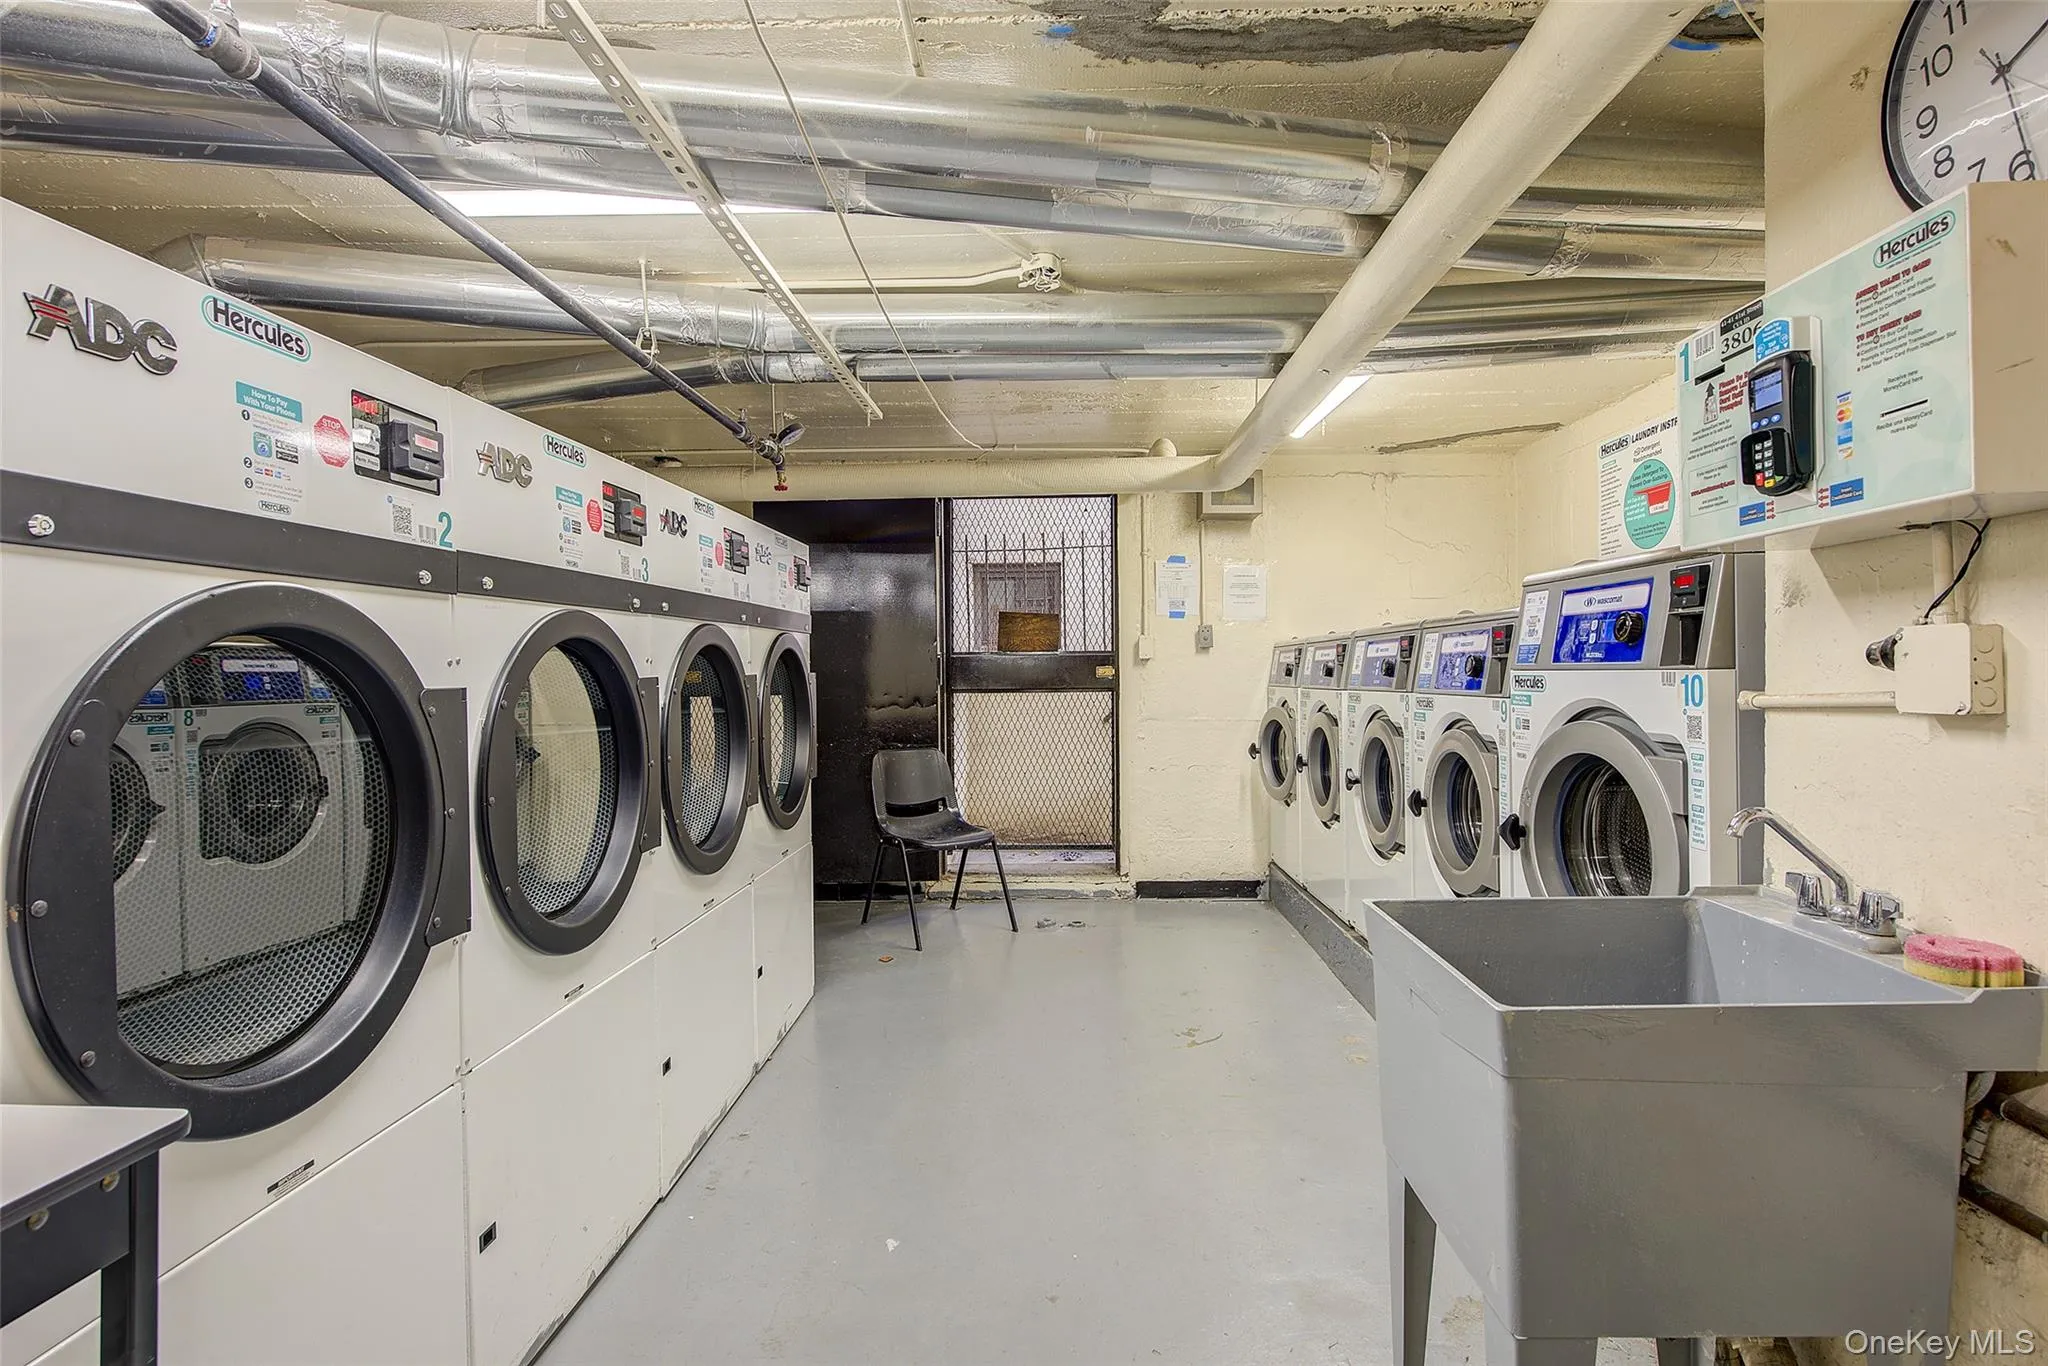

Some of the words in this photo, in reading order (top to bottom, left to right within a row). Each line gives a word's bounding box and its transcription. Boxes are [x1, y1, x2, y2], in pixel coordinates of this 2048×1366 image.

[1943, 1, 1967, 35] 11
[1920, 44, 1953, 87] 10
[1916, 105, 1938, 139] 9
[1934, 144, 1955, 178] 8
[1967, 157, 1986, 182] 7
[1880, 216, 1949, 263] Hercules
[1902, 276, 1914, 285] Card
[1894, 288, 1906, 298] Type
[212, 297, 305, 357] Hercules
[1878, 311, 1890, 320] Card
[22, 283, 178, 376] ADC
[1679, 342, 1690, 382] 1
[1883, 379, 1911, 394] MoneyCard
[1911, 375, 1924, 384] here
[1887, 373, 1907, 384] Receive
[1907, 369, 1919, 378] new
[243, 395, 260, 407] With
[260, 400, 276, 412] Your
[276, 406, 296, 418] Phone
[251, 389, 267, 400] How
[267, 394, 276, 403] To
[276, 397, 288, 408] Pay
[322, 419, 341, 430] STOP
[1903, 409, 1933, 424] MoneyCard
[546, 435, 584, 464] Hercules
[1600, 437, 1629, 457] Hercules
[1631, 424, 1659, 444] LAUNDRY
[1641, 440, 1661, 453] Detergent
[476, 441, 533, 488] ADC
[1633, 448, 1662, 463] Recommended
[260, 501, 290, 513] Hercules
[438, 512, 453, 548] 2
[659, 508, 688, 538] ADC
[641, 557, 649, 583] 3
[1597, 595, 1623, 605] wascomat
[1514, 675, 1544, 690] Hercules
[1680, 673, 1704, 708] 10
[1404, 694, 1410, 713] 8
[1500, 700, 1508, 723] 9
